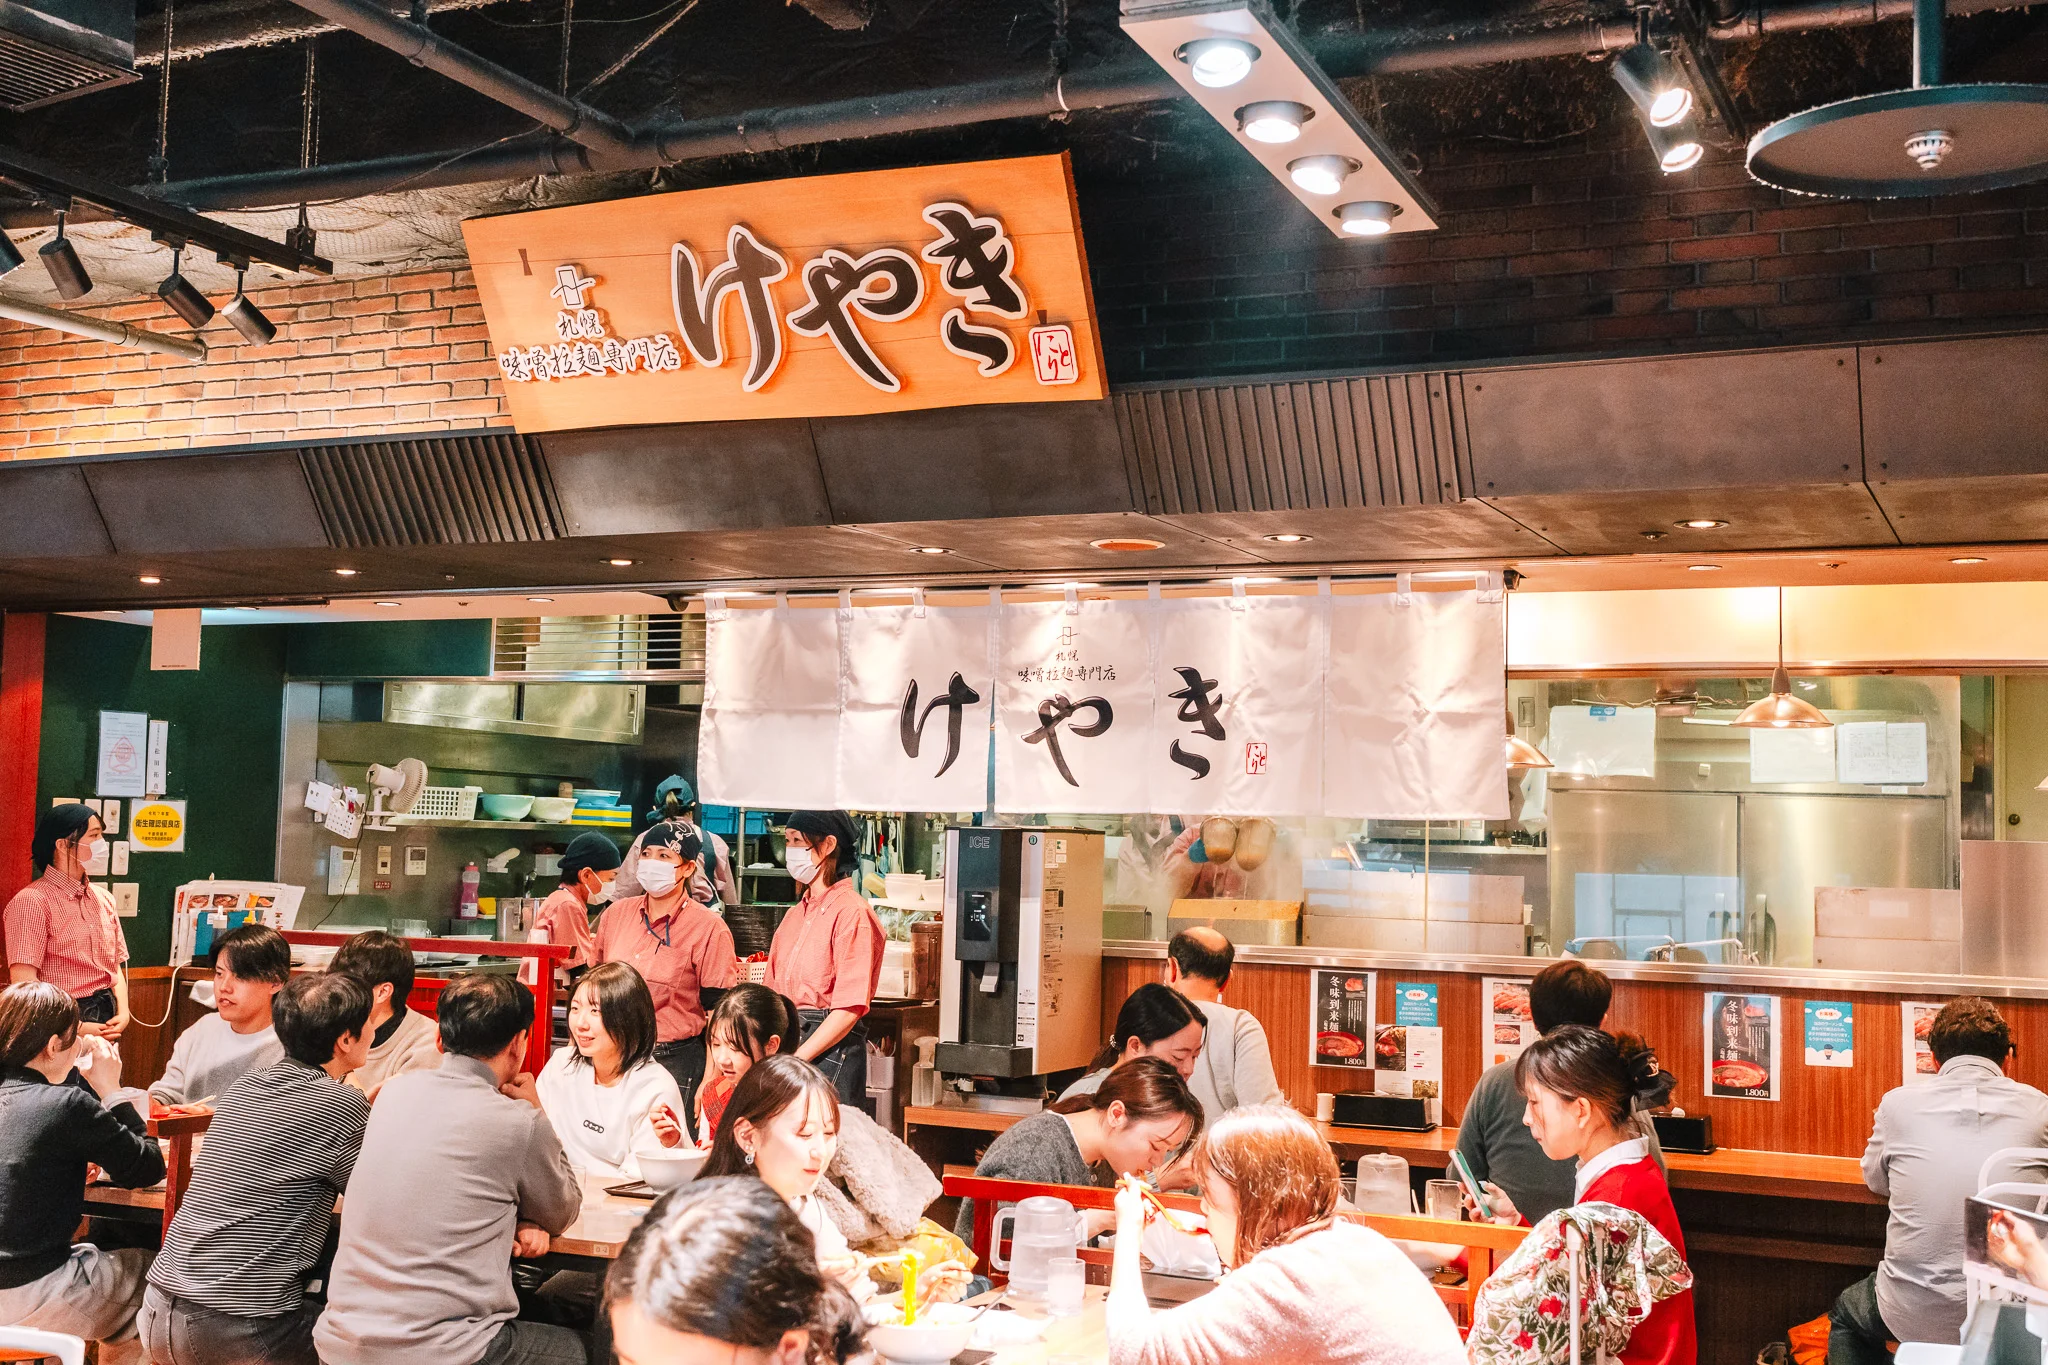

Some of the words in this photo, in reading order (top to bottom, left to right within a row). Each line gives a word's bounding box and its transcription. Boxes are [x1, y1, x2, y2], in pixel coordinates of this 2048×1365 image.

[674, 205, 1025, 390] けやき
[558, 312, 602, 338] 札幌
[1056, 649, 1079, 661] 札幌
[900, 666, 1226, 788] けやき
[135, 819, 181, 829] 衛生確認優良店
[969, 836, 990, 849] ICE
